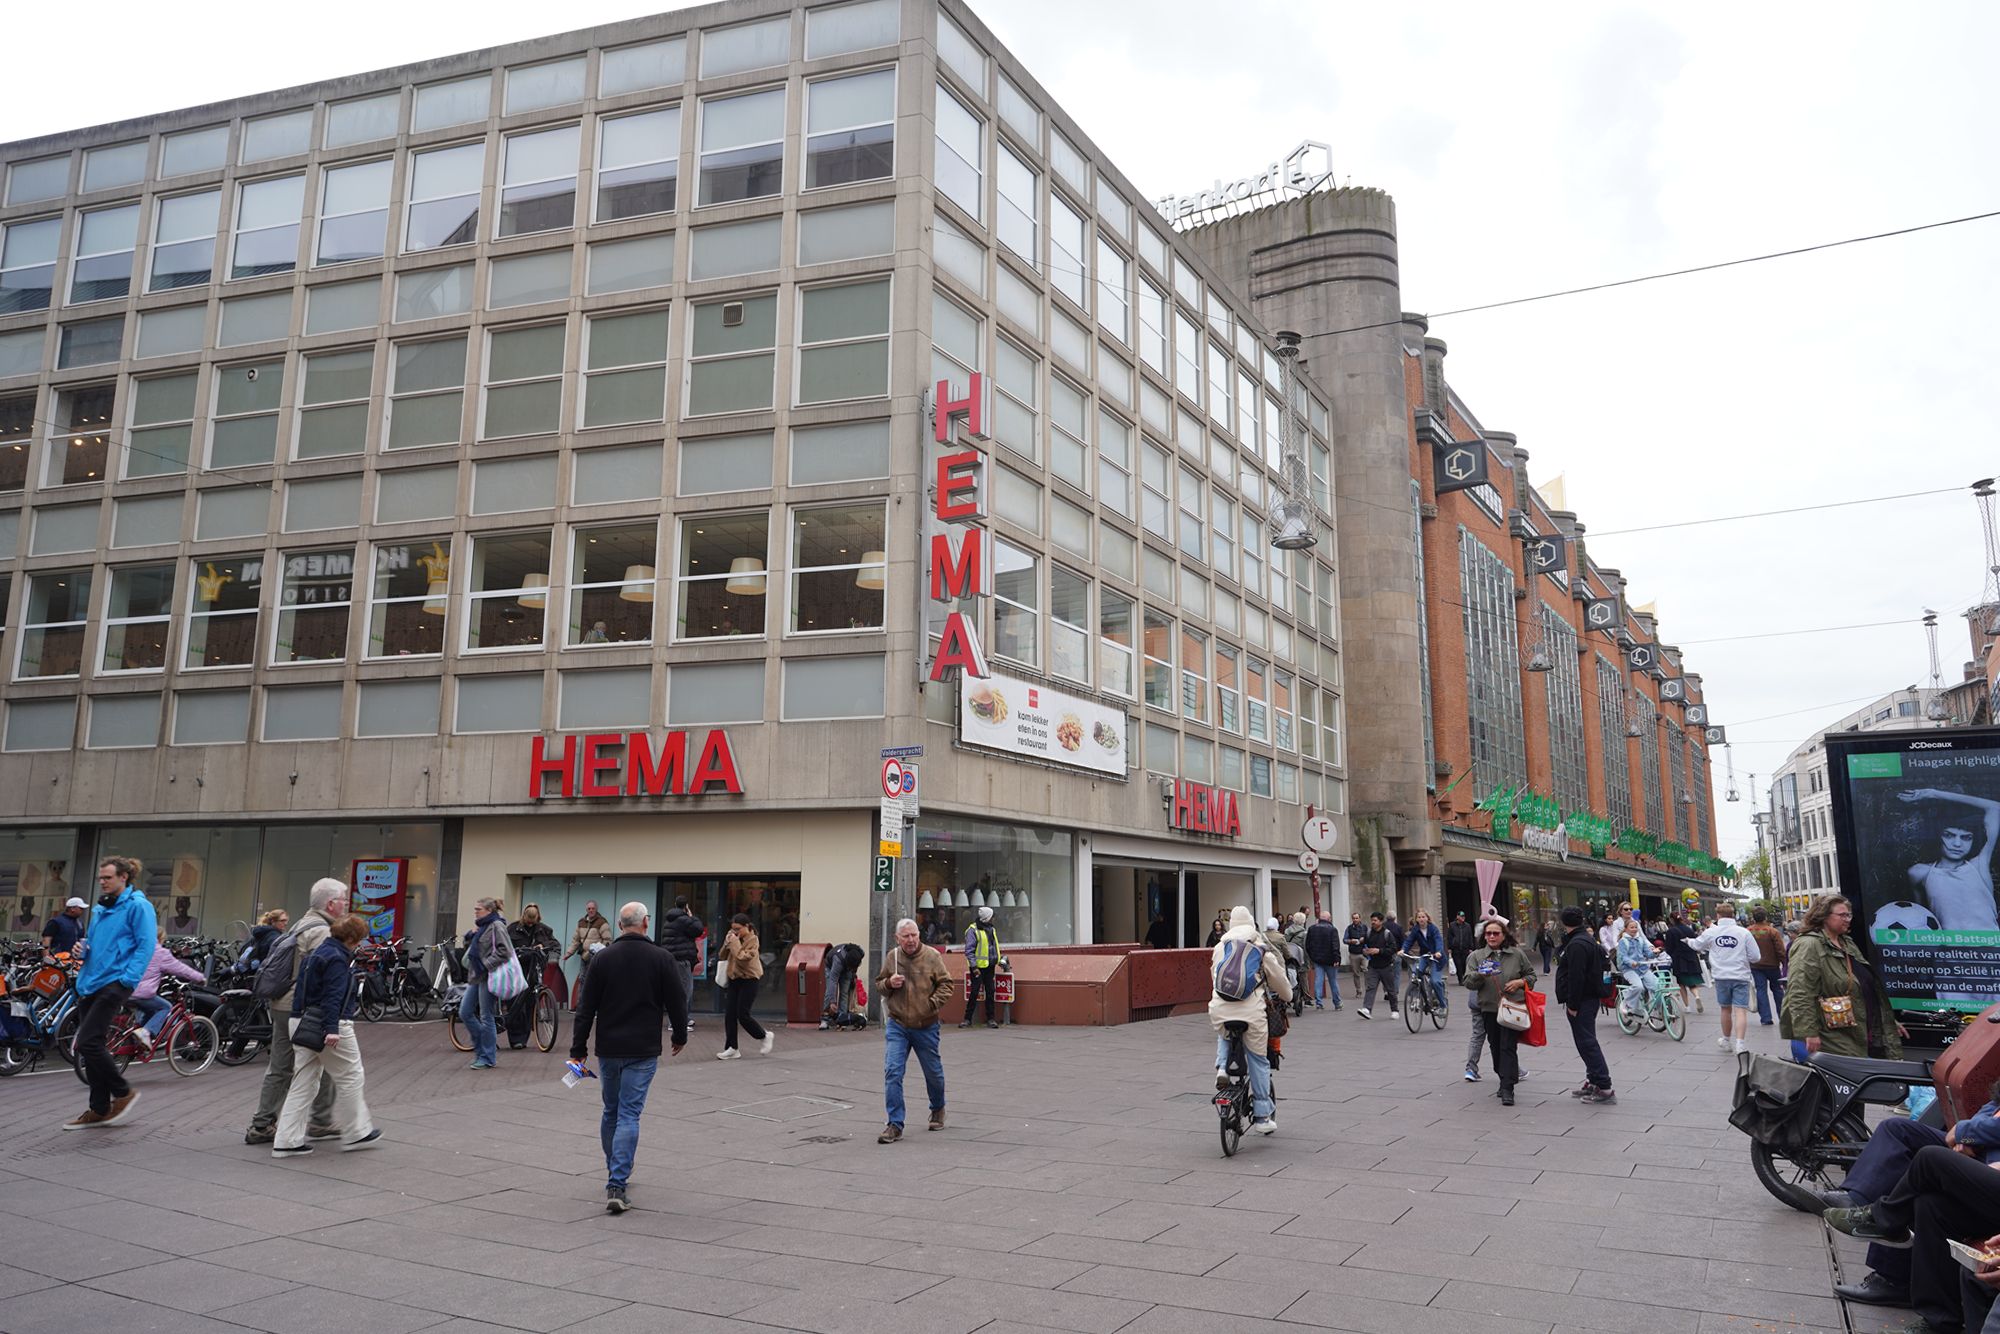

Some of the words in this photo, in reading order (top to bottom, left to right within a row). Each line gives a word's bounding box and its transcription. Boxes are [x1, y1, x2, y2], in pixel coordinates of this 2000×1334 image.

[1151, 162, 1279, 226] ijenkorf
[929, 372, 992, 681] HEMA
[1017, 710, 1031, 721] kom
[1031, 712, 1049, 725] lekker
[1017, 724, 1031, 734] eten
[1031, 725, 1038, 736] in
[1038, 729, 1048, 737] ons
[1017, 737, 1047, 750] restaurant
[1909, 741, 1953, 749] JCDecaux
[529, 729, 744, 798] HEMA
[1908, 758, 1952, 769] Haagse
[1174, 778, 1242, 837] HEMA
[1520, 802, 1532, 810] 100
[1494, 817, 1508, 825] 100
[885, 829, 893, 839] 60
[893, 832, 899, 840] m
[1319, 821, 1329, 840] F
[876, 857, 889, 876] P
[1914, 933, 1953, 943] Letizia
[1882, 948, 1897, 958] De
[1900, 948, 1932, 958] harde
[1934, 949, 1979, 960] realiteit
[1980, 952, 2000, 960] van
[1884, 963, 1903, 974] het
[1905, 964, 1935, 975] leven
[1936, 967, 1951, 976] op
[1953, 965, 1988, 976] Sicilië
[1990, 966, 2000, 976] in
[1886, 979, 1934, 990] schaduw
[1936, 983, 1956, 991] van
[1958, 982, 1973, 991] de
[1834, 1084, 1850, 1095] V8
